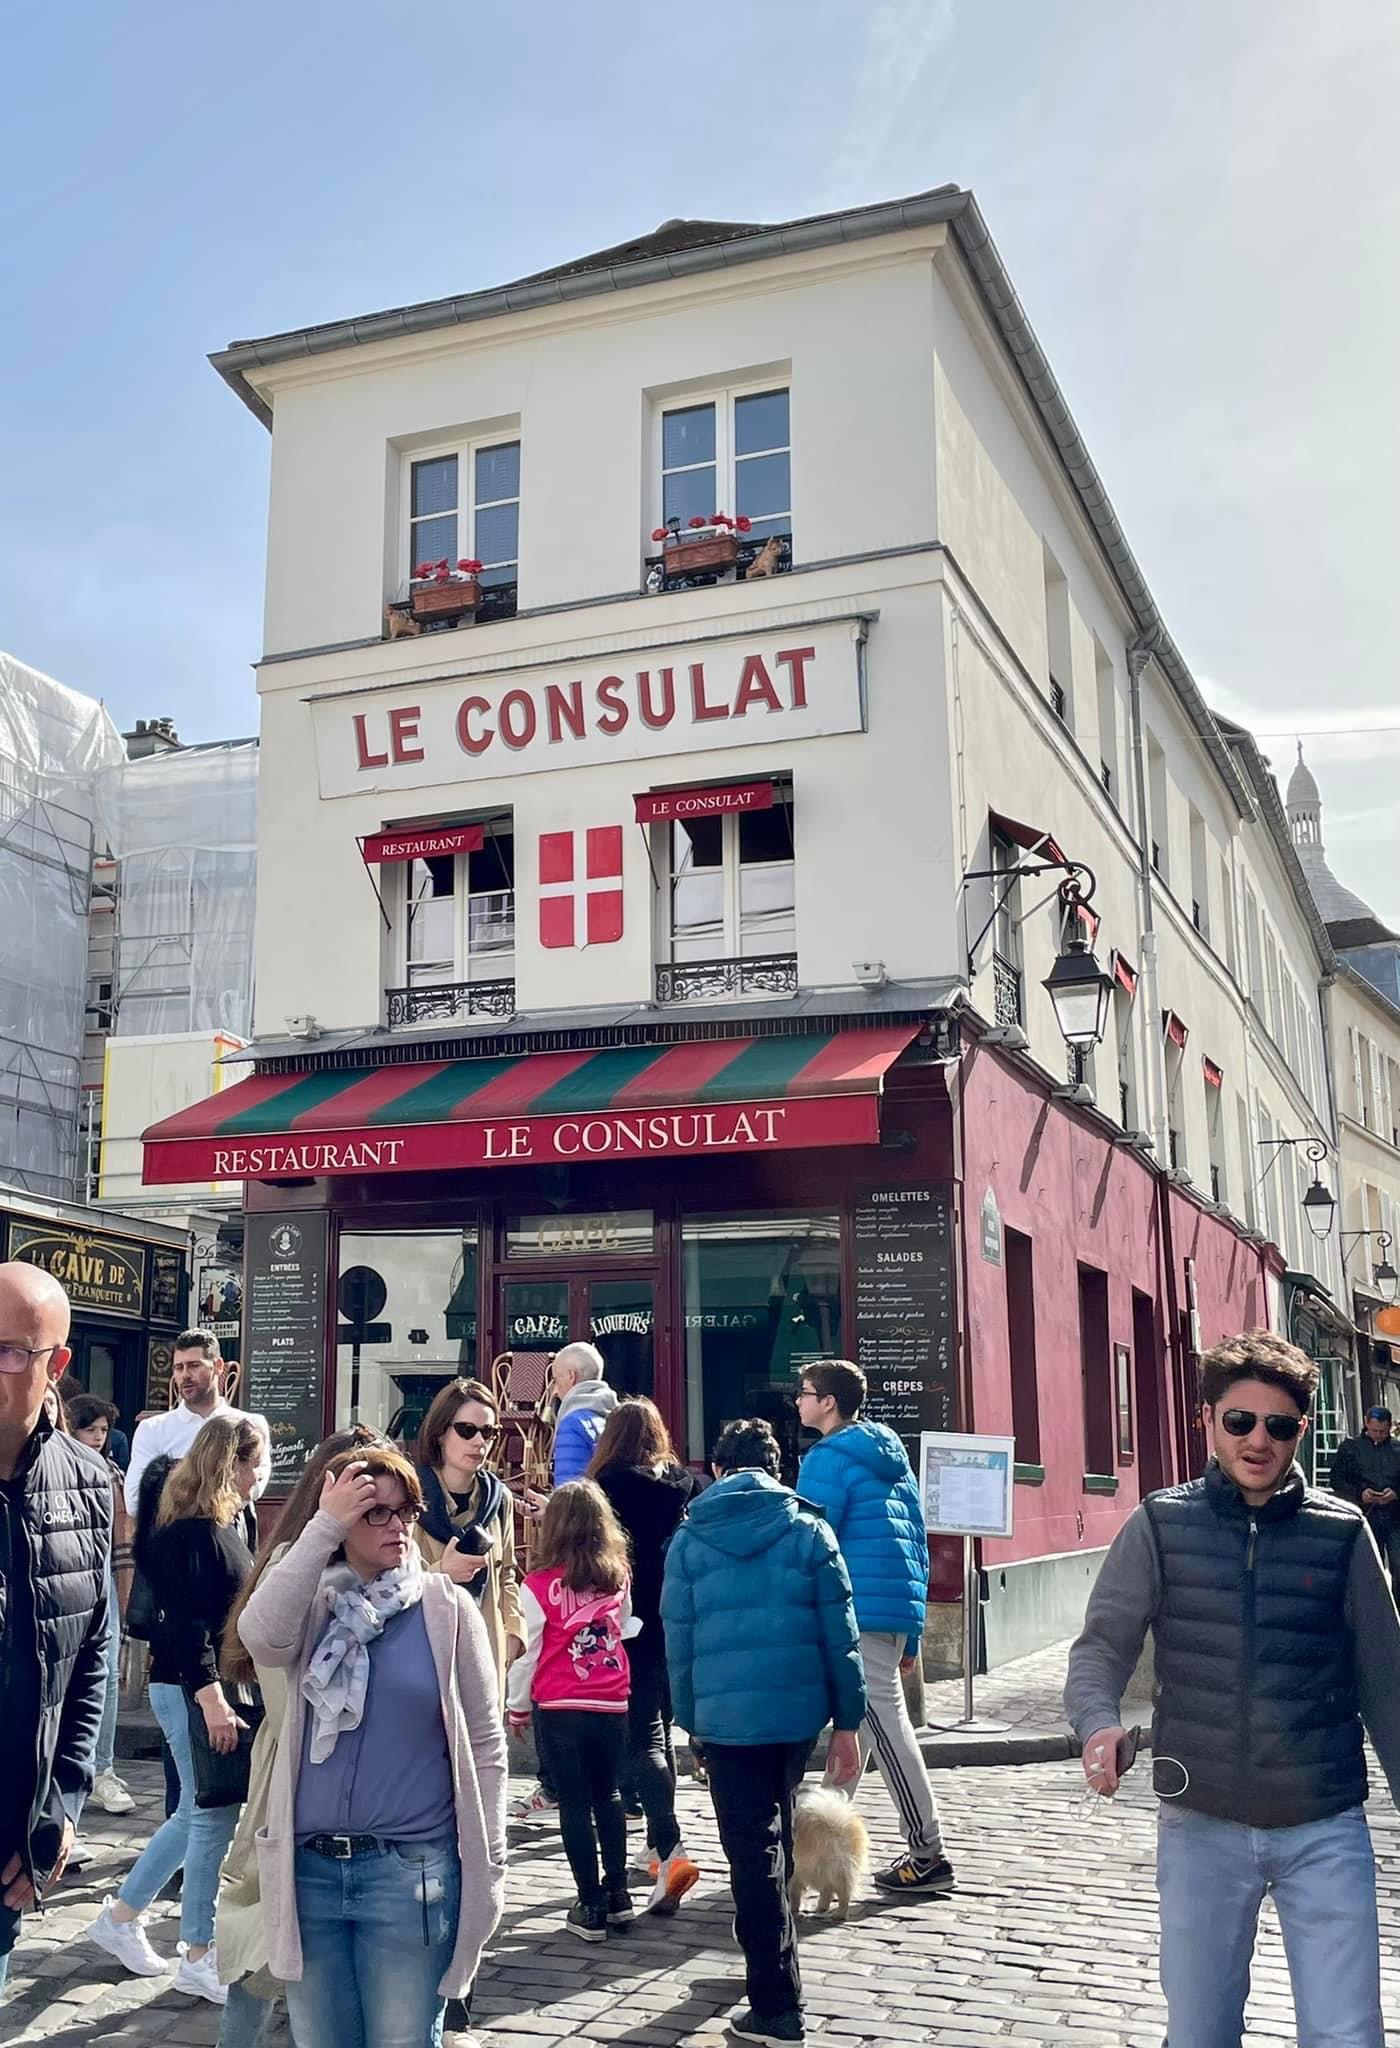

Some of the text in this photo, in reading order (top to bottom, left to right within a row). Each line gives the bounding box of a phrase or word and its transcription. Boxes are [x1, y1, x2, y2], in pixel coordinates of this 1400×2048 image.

[352, 646, 815, 771] LE CONSULAT
[651, 792, 755, 815] LE CONSULAT
[382, 835, 464, 856] RESTAURANT
[213, 1108, 786, 1175] RESTAURANT LE CONSULAT
[872, 1191, 930, 1203] OMELETTES
[32, 1249, 125, 1285] LA CAVE DE
[876, 1252, 924, 1263] SALADES
[590, 1314, 650, 1337] LIQUEURS
[272, 1338, 295, 1346] PLATS
[883, 1380, 924, 1391] CRÊPES
[43, 1510, 81, 1524] OMEGA
[898, 1865, 917, 1884] N
